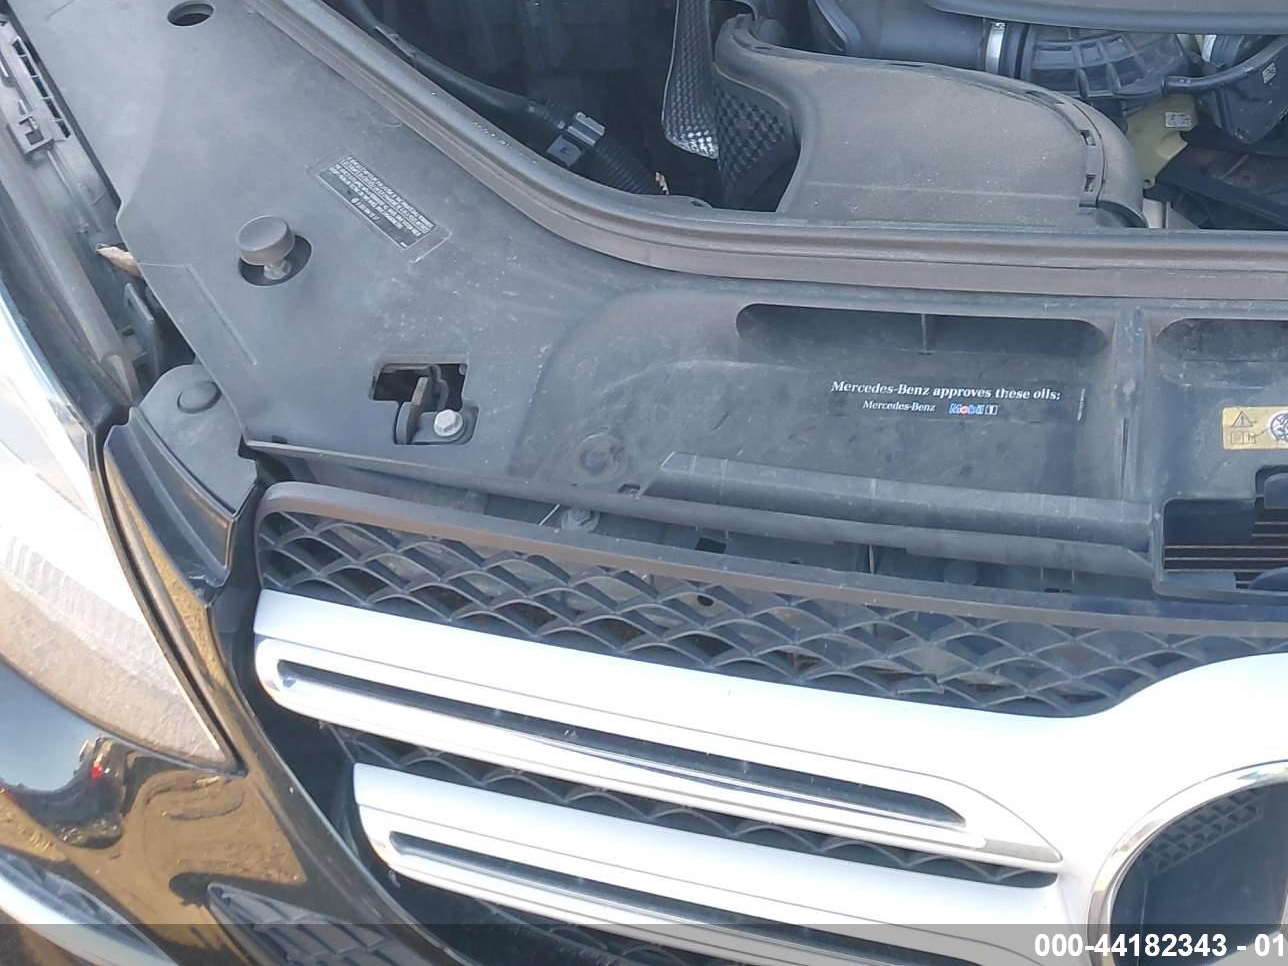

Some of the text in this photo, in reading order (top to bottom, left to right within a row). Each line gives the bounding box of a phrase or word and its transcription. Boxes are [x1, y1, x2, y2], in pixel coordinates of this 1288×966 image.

[831, 381, 1061, 400] Mercedes-Benz approves these oils:
[862, 400, 936, 412] Mercedes-Benz
